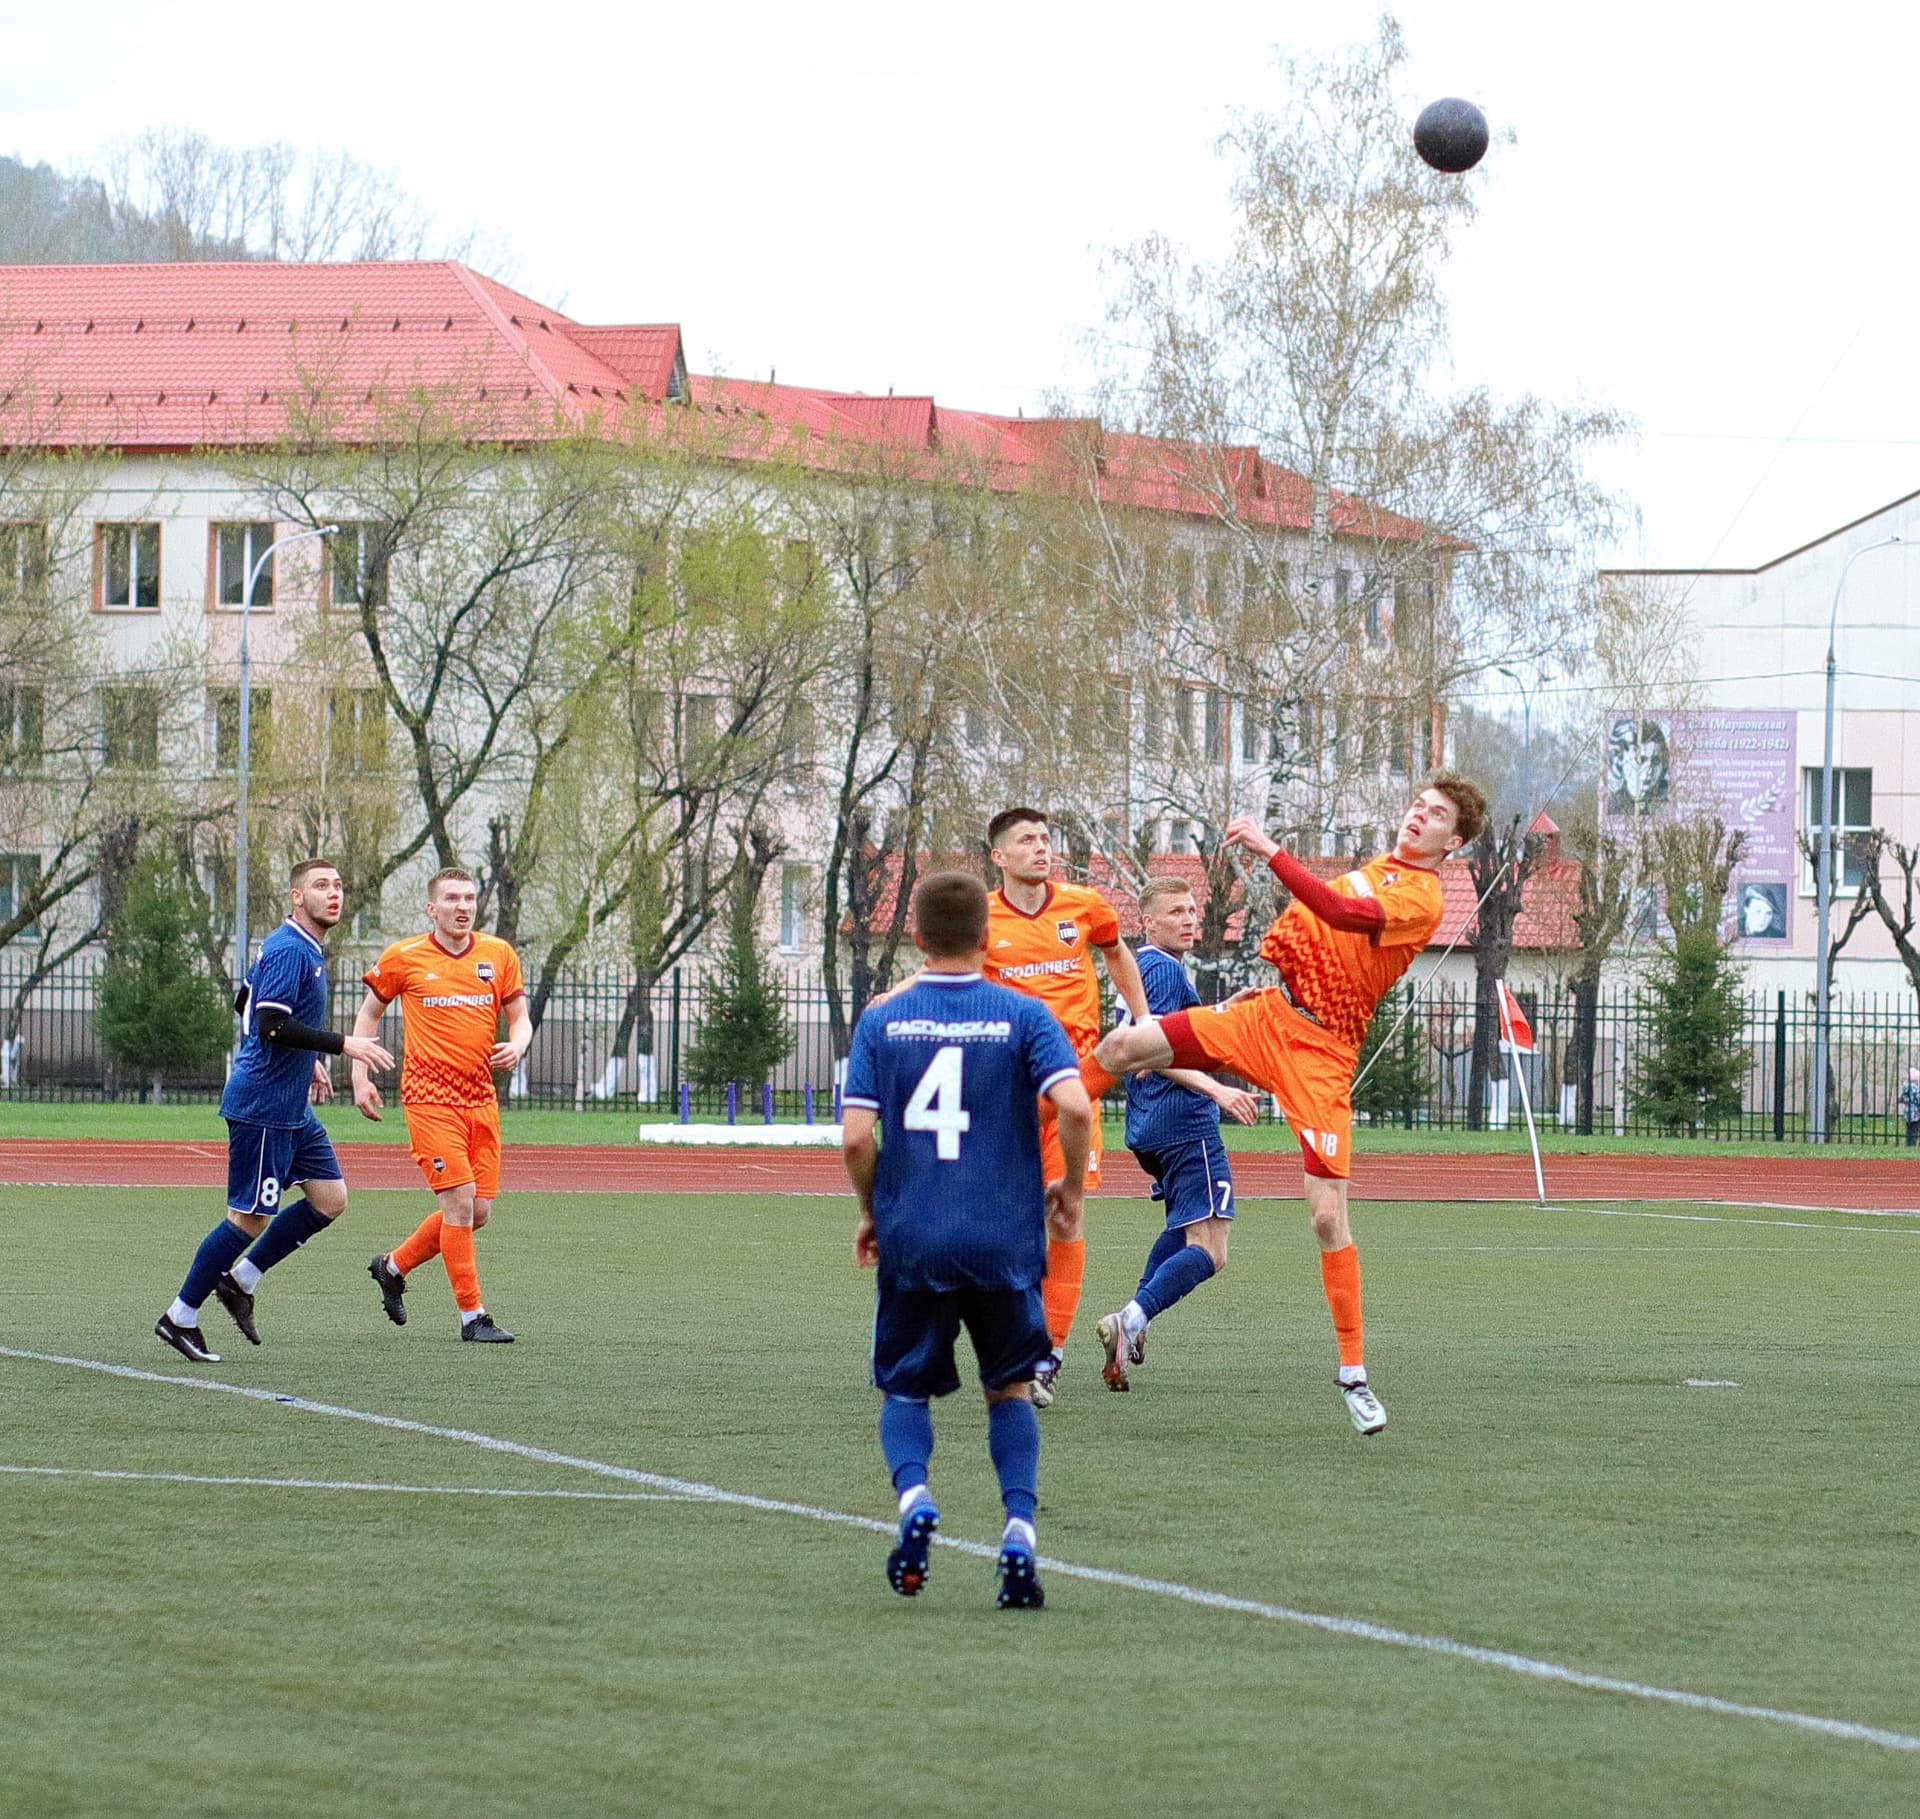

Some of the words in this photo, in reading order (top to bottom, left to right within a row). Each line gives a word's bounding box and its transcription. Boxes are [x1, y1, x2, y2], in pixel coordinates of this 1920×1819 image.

[1728, 738, 1791, 752] (1922-1942)
[903, 1046, 970, 1160] 4
[1320, 1132, 1338, 1157] 18
[261, 1177, 279, 1207] 8
[1217, 1181, 1231, 1211] 7
